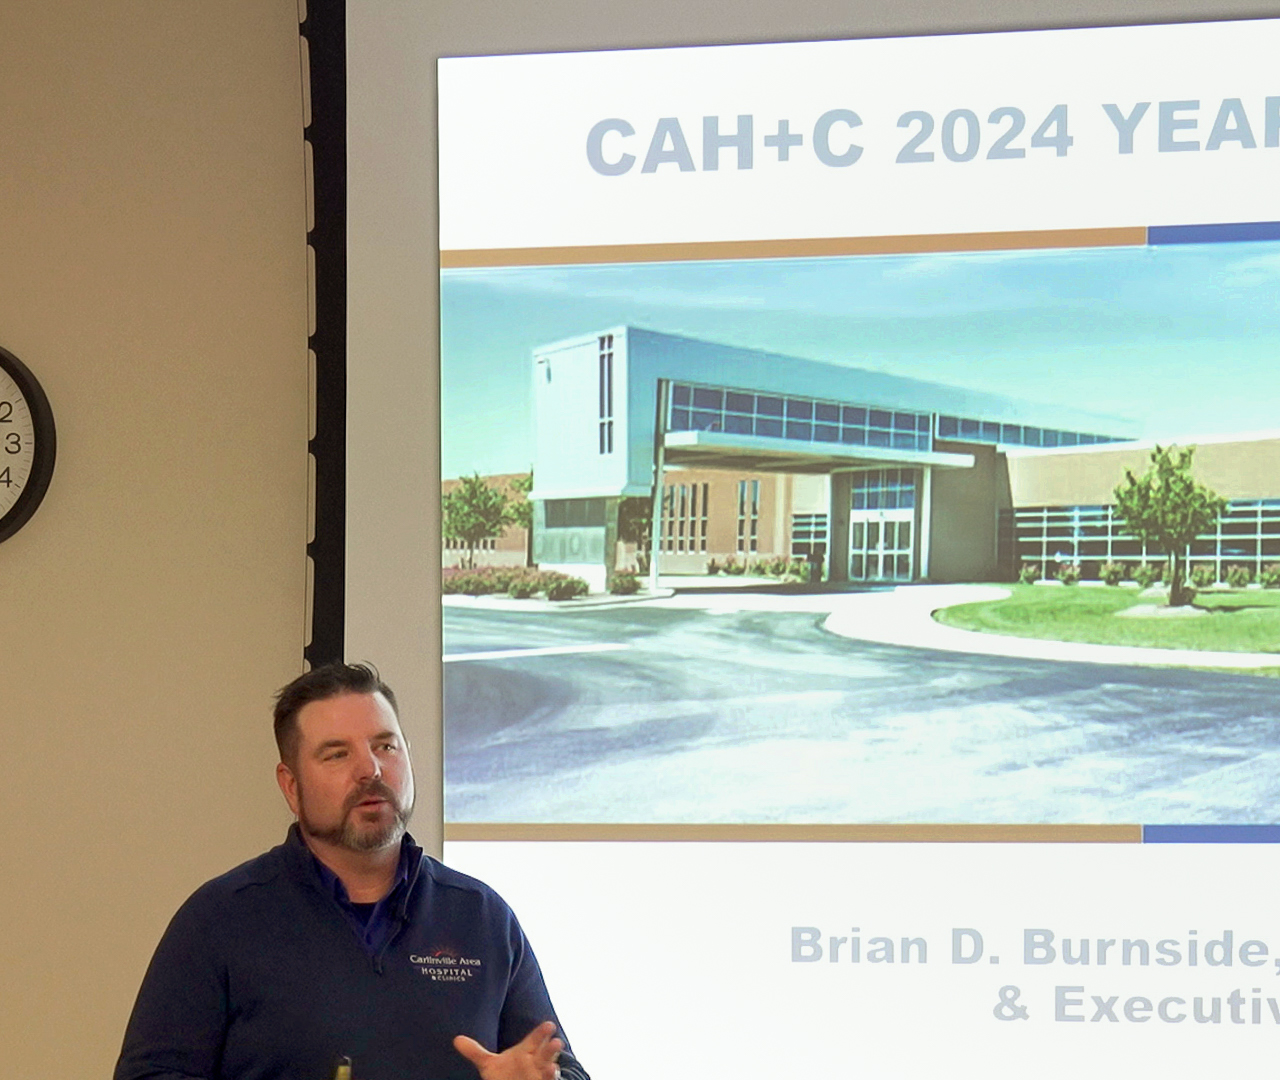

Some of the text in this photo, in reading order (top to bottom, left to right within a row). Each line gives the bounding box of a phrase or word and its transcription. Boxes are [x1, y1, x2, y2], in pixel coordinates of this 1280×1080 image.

[586, 108, 865, 176] CAH+C
[895, 104, 1074, 164] 2024
[5, 433, 21, 454] 3
[791, 926, 928, 964] Brian
[951, 928, 1000, 965] D.
[421, 967, 473, 977] HOSPITAL
[992, 985, 1030, 1021] &
